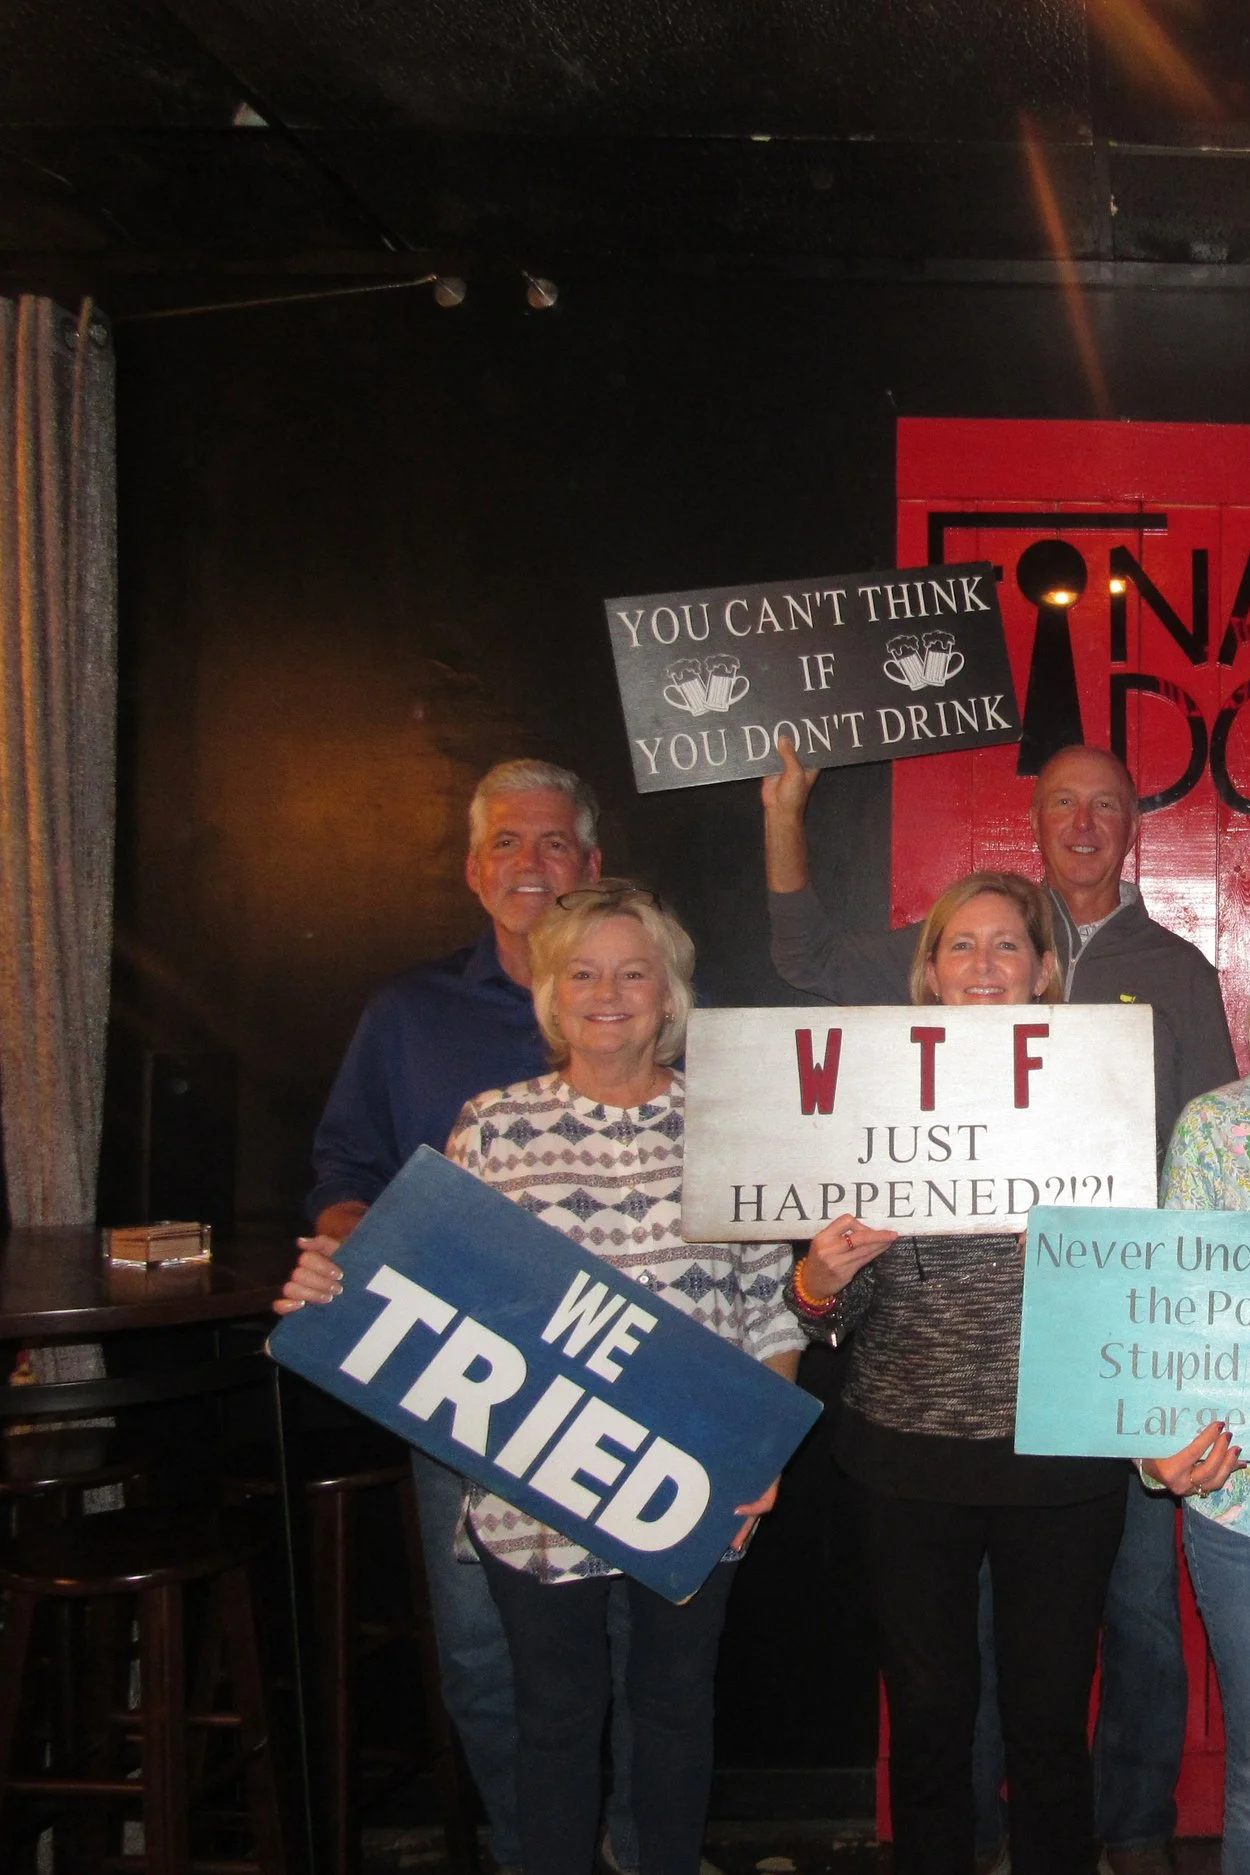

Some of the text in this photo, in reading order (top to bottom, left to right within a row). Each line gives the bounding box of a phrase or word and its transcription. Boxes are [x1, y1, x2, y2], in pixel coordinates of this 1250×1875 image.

[617, 576, 991, 648] YOU CAN'T THINK
[798, 653, 836, 692] IF
[636, 695, 1012, 775] YOU DON'T DRINK
[857, 1124, 988, 1165] JUST
[1036, 1232, 1167, 1270] Never
[540, 1269, 659, 1385] WE
[1125, 1286, 1197, 1326] the
[1099, 1342, 1240, 1391] Stupid
[339, 1264, 712, 1553] TRIED
